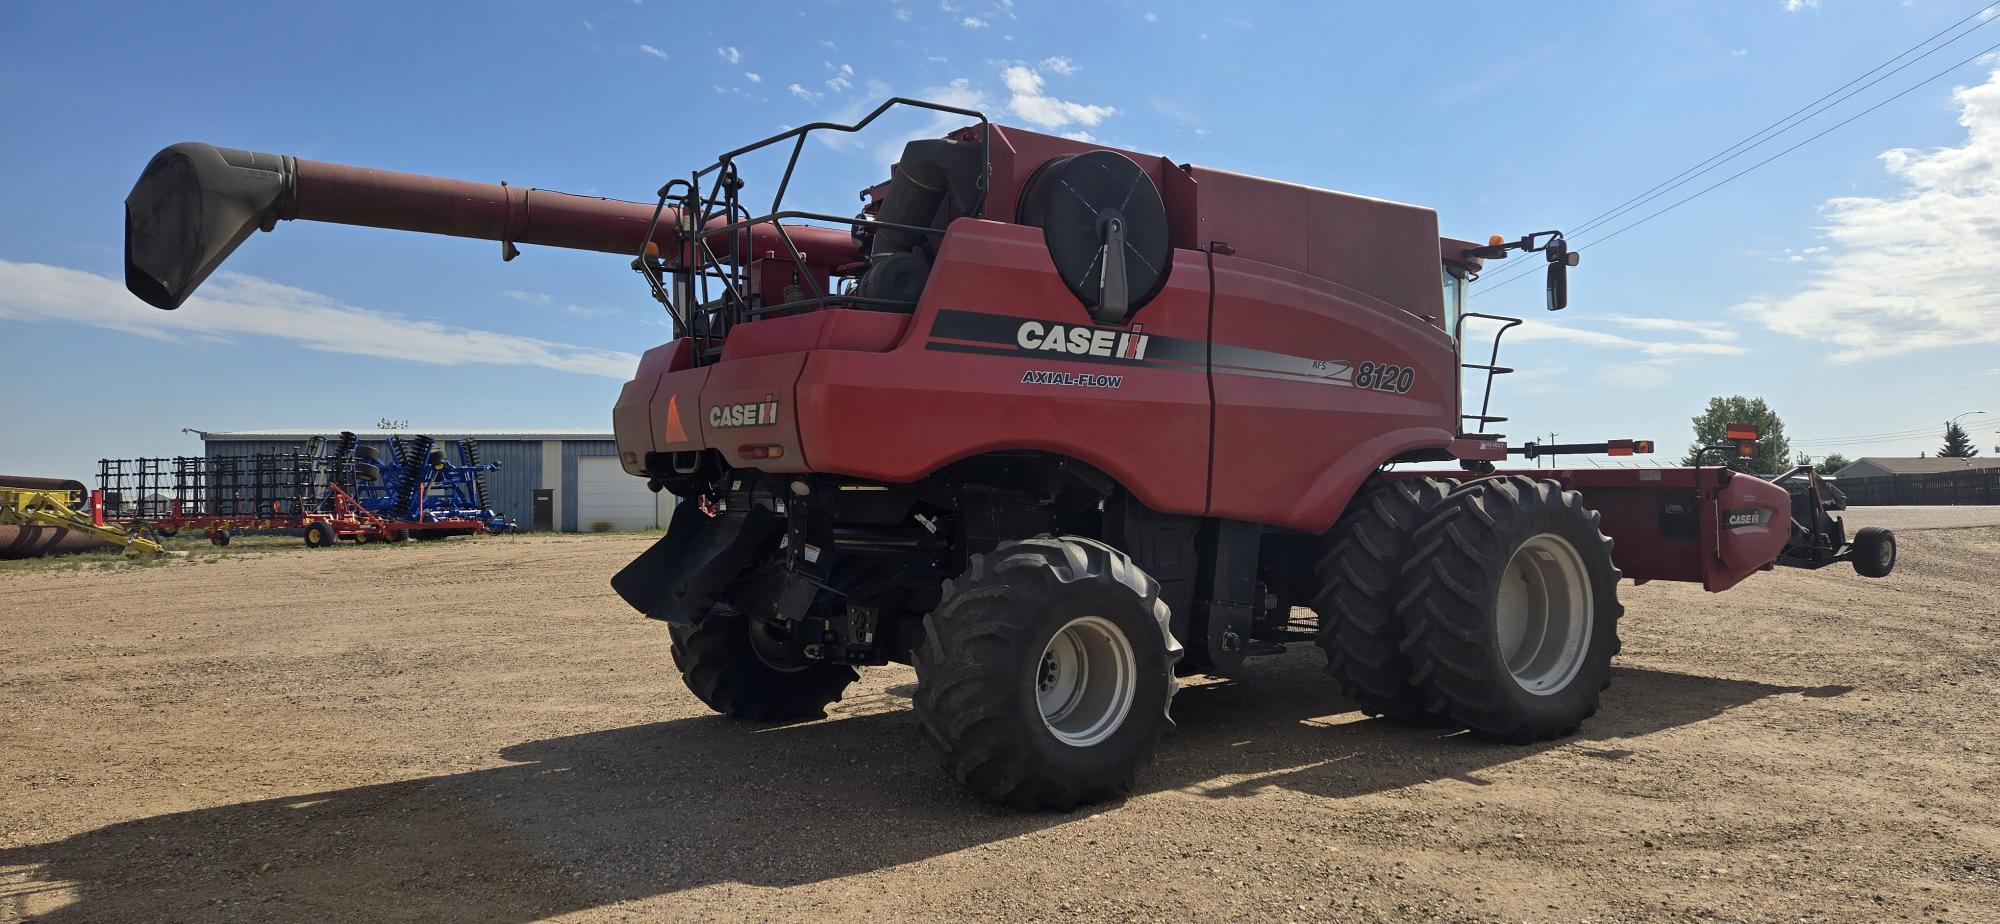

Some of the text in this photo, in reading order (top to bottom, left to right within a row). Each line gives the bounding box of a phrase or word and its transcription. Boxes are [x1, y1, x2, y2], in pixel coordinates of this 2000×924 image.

[1017, 321, 1116, 355] CASE
[1312, 361, 1327, 370] AFS
[1021, 370, 1123, 388] AXIAL-FLOW
[1356, 360, 1415, 394] 8120
[709, 404, 757, 428] CASE
[1729, 514, 1752, 525] CASE
